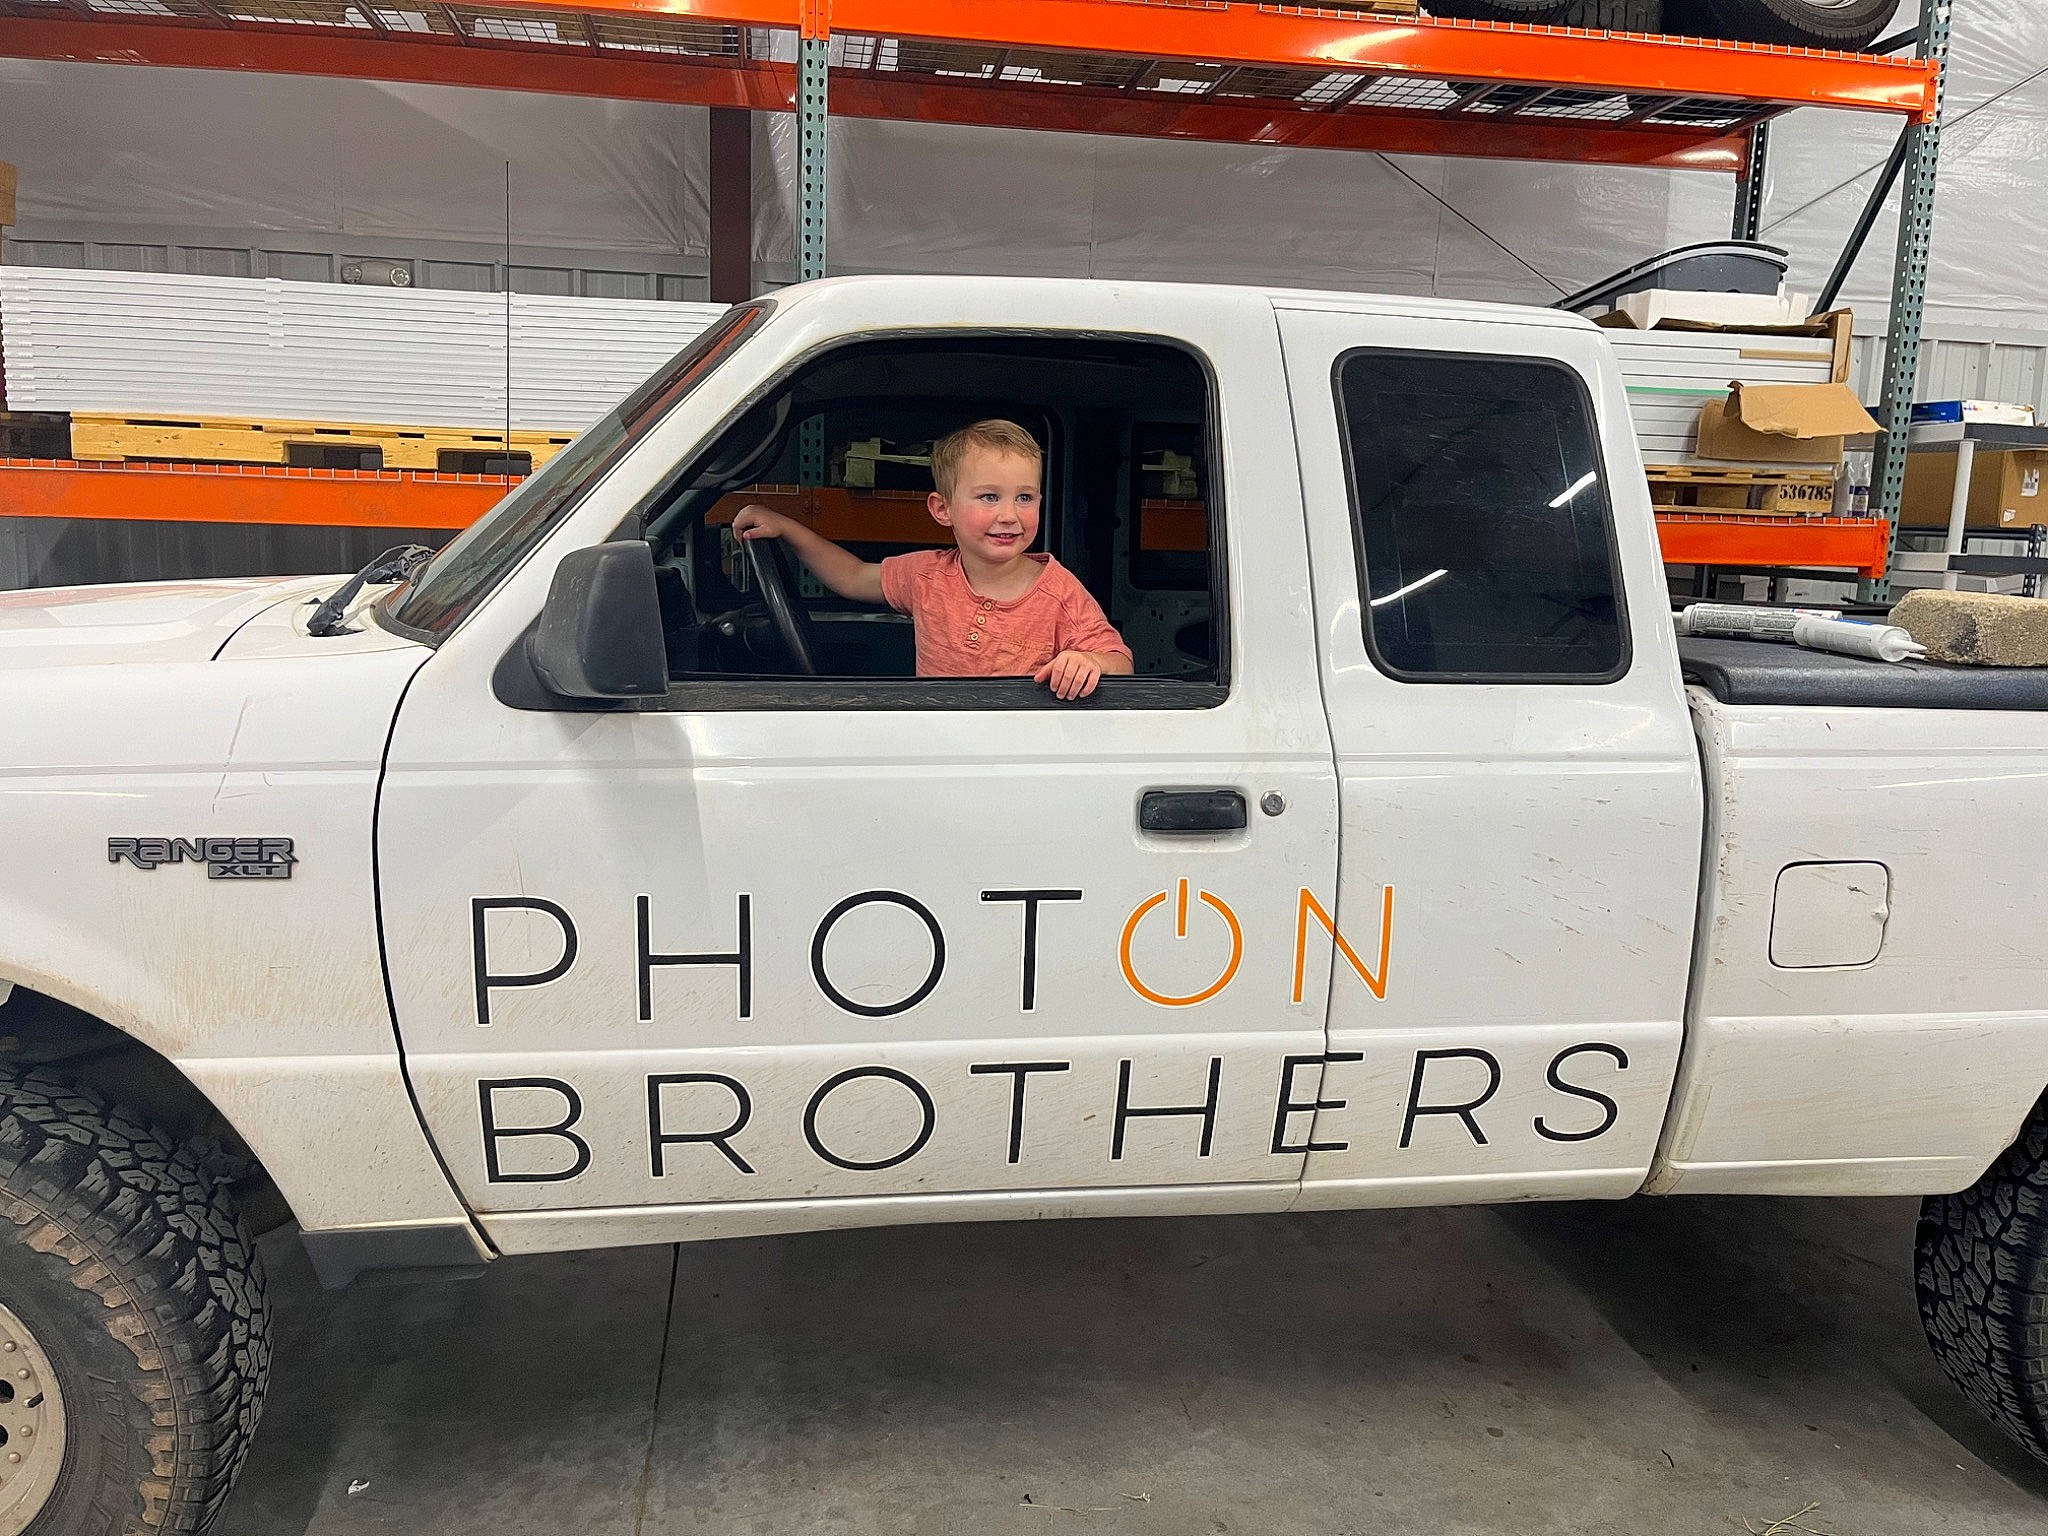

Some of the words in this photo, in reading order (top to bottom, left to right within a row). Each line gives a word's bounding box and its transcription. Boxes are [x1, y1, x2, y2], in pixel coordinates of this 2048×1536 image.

[1779, 484, 1833, 501] 536785
[215, 864, 282, 877] XLT
[471, 877, 1395, 1026] PHOTON
[477, 1042, 1630, 1184] BROTHERS
